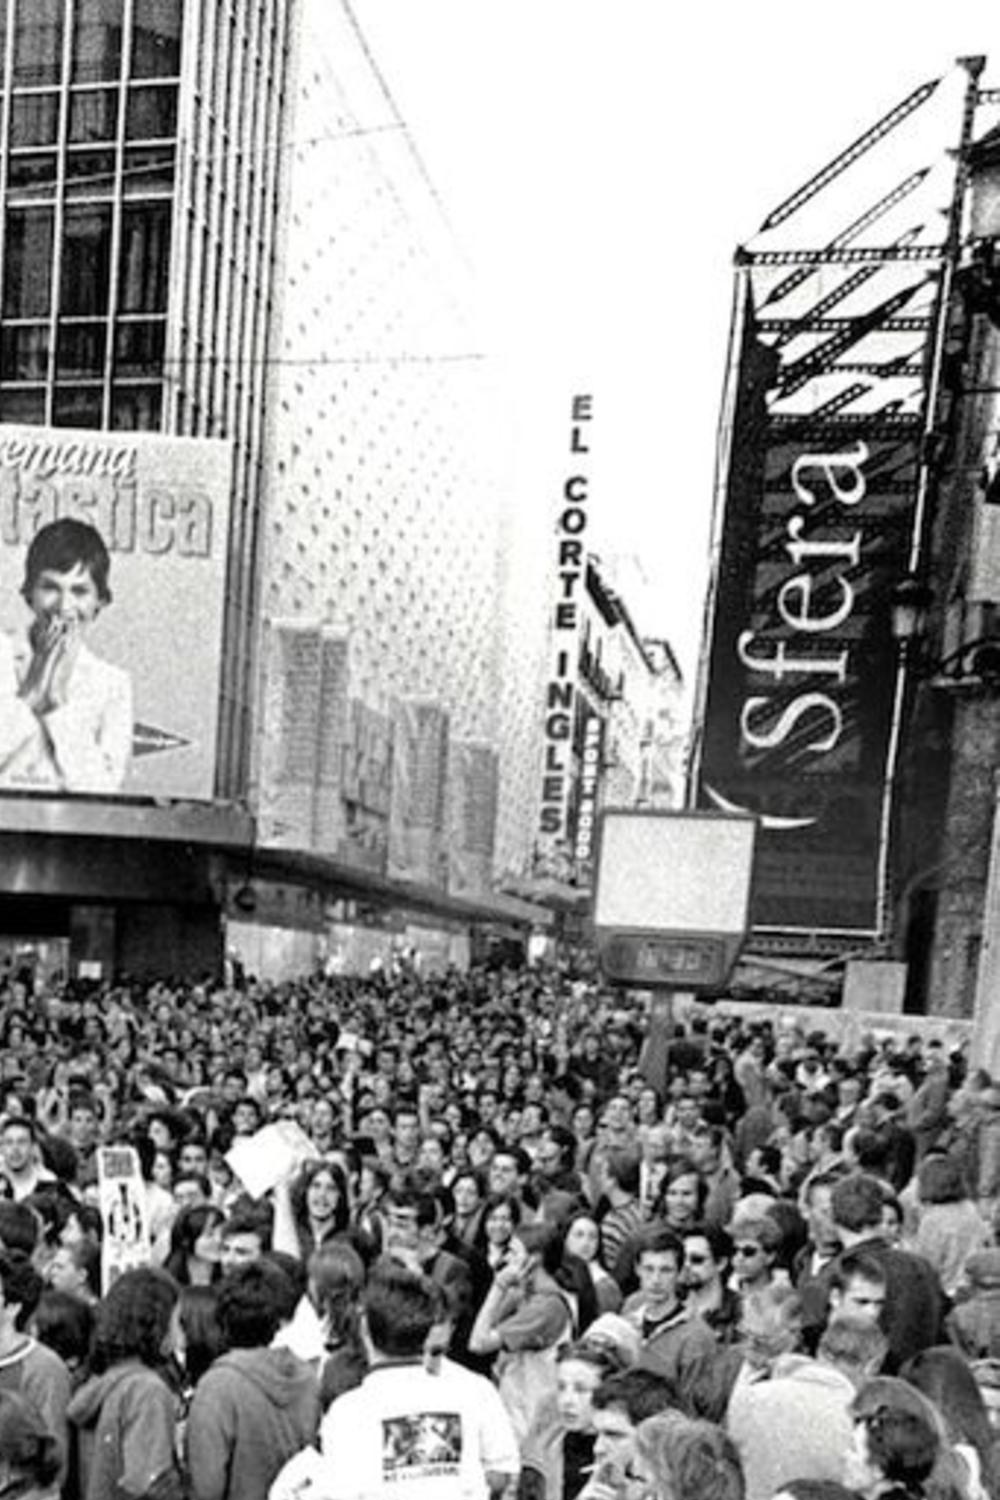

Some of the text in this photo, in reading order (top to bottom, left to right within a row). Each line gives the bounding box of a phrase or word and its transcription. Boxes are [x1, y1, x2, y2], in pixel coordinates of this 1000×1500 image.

[540, 394, 593, 834] EL CORTE INGLES
[737, 438, 870, 752] Sfera
